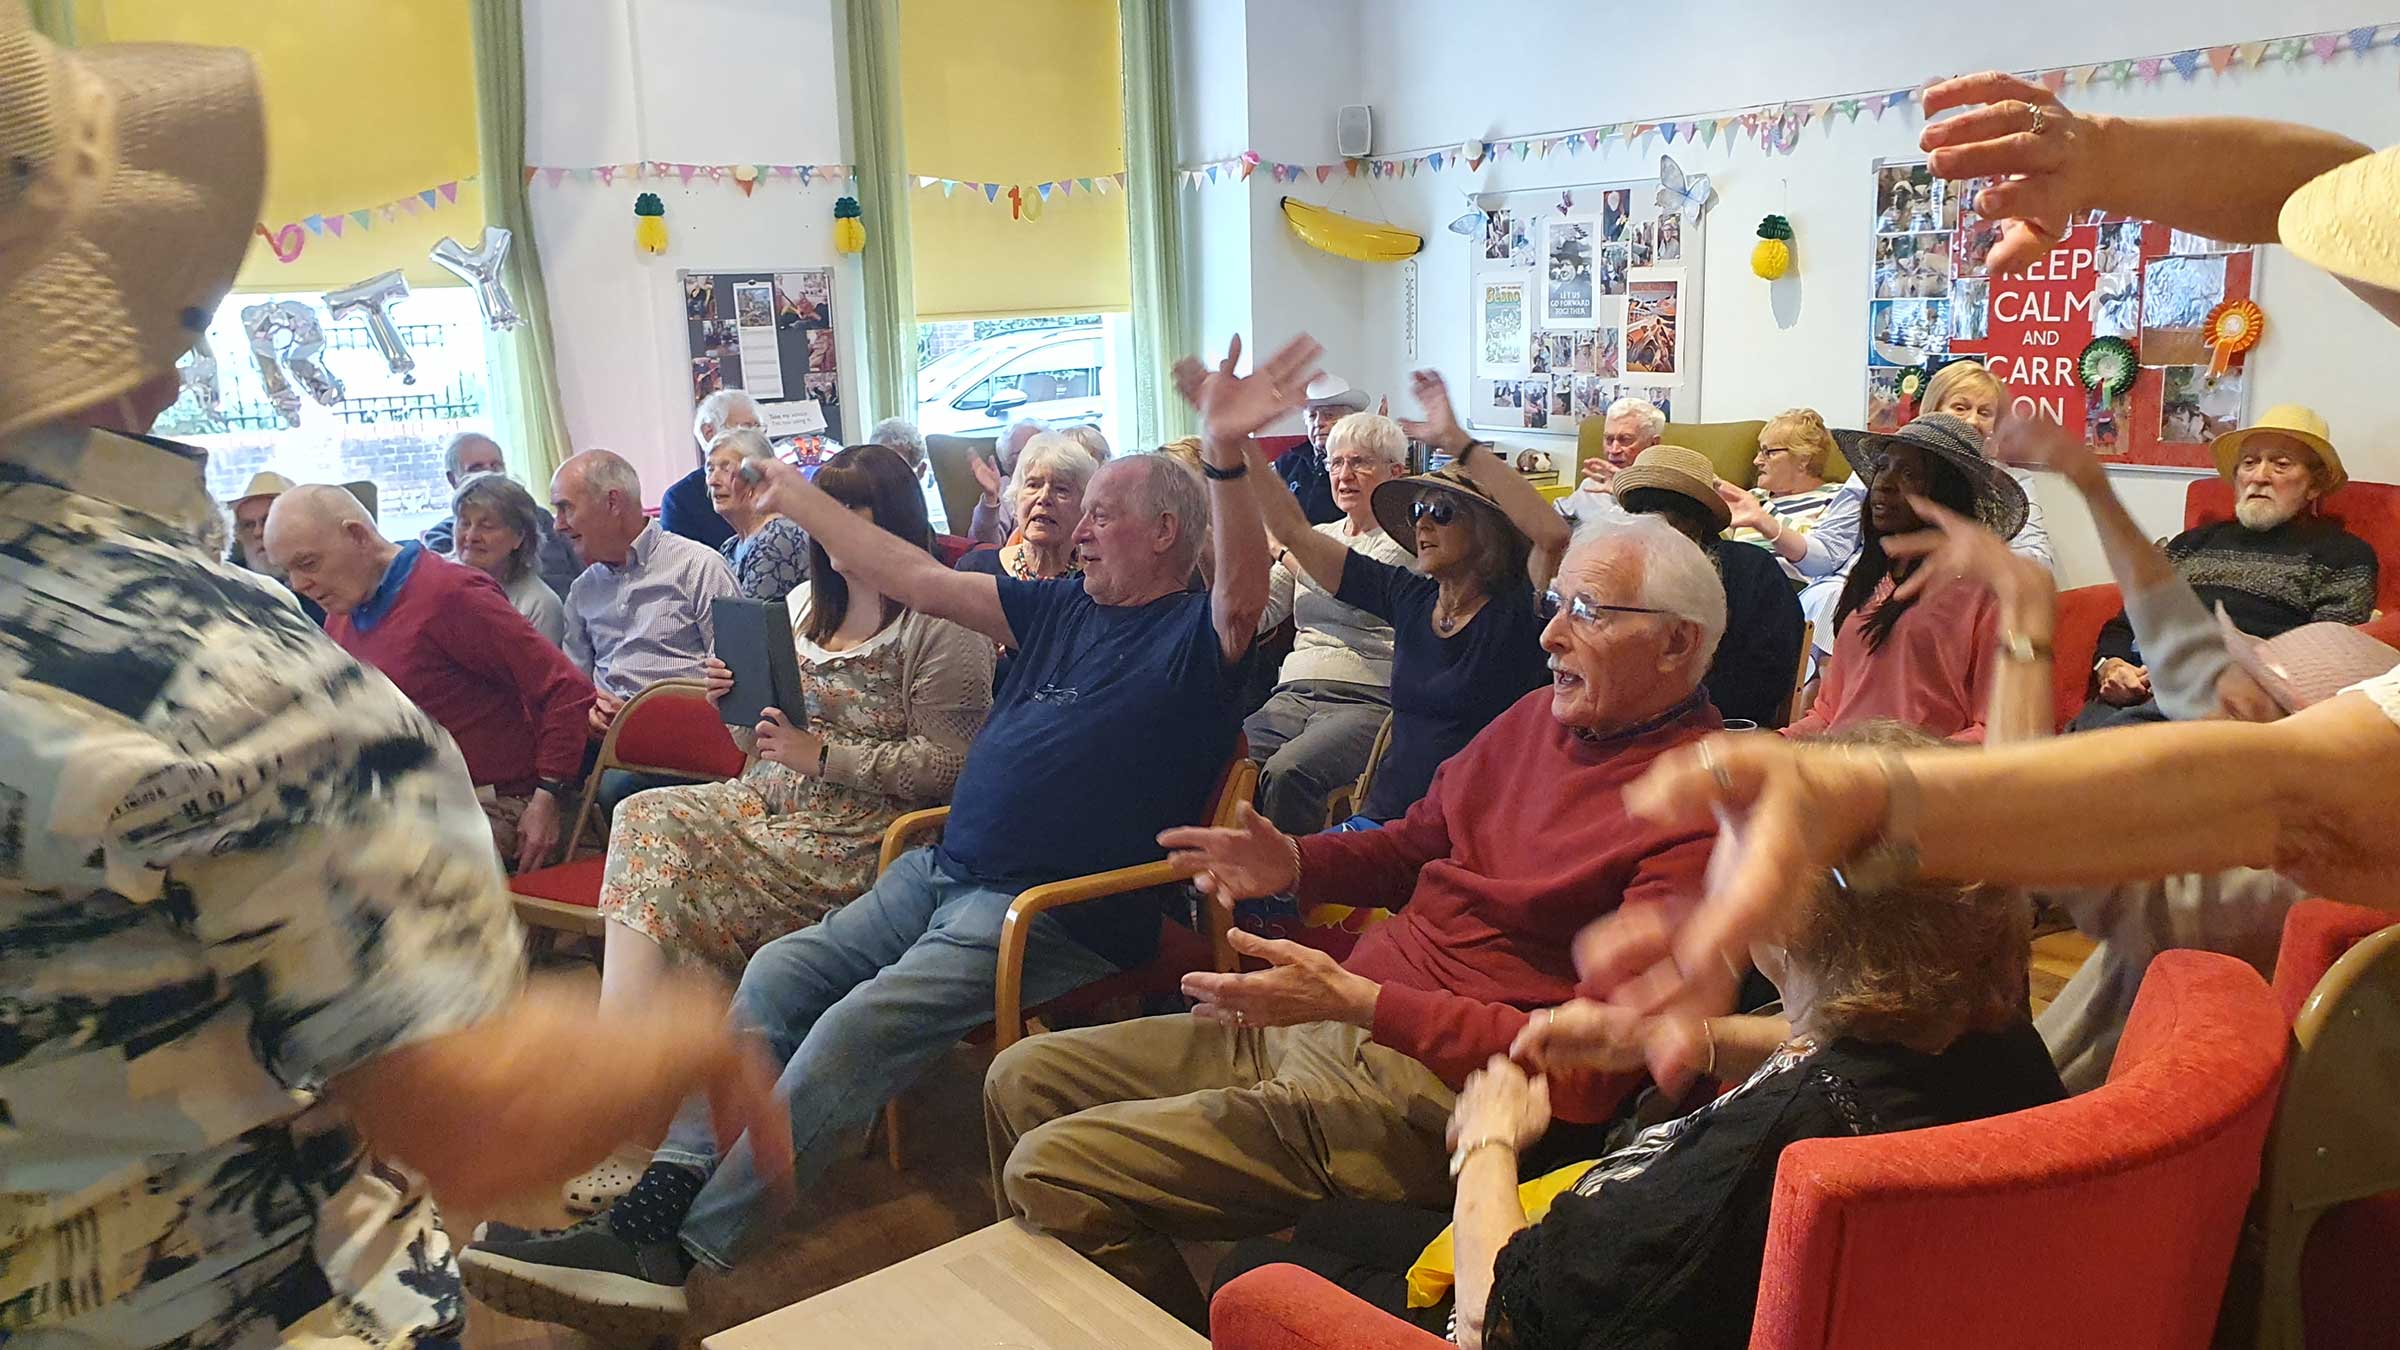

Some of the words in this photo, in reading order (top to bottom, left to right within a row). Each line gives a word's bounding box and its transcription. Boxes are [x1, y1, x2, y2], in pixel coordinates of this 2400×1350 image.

[2002, 248, 2093, 281] EEP
[1993, 290, 2096, 323] CALM
[2022, 329, 2060, 347] AND
[1985, 355, 2081, 387] CARR
[2011, 395, 2065, 427] ON
